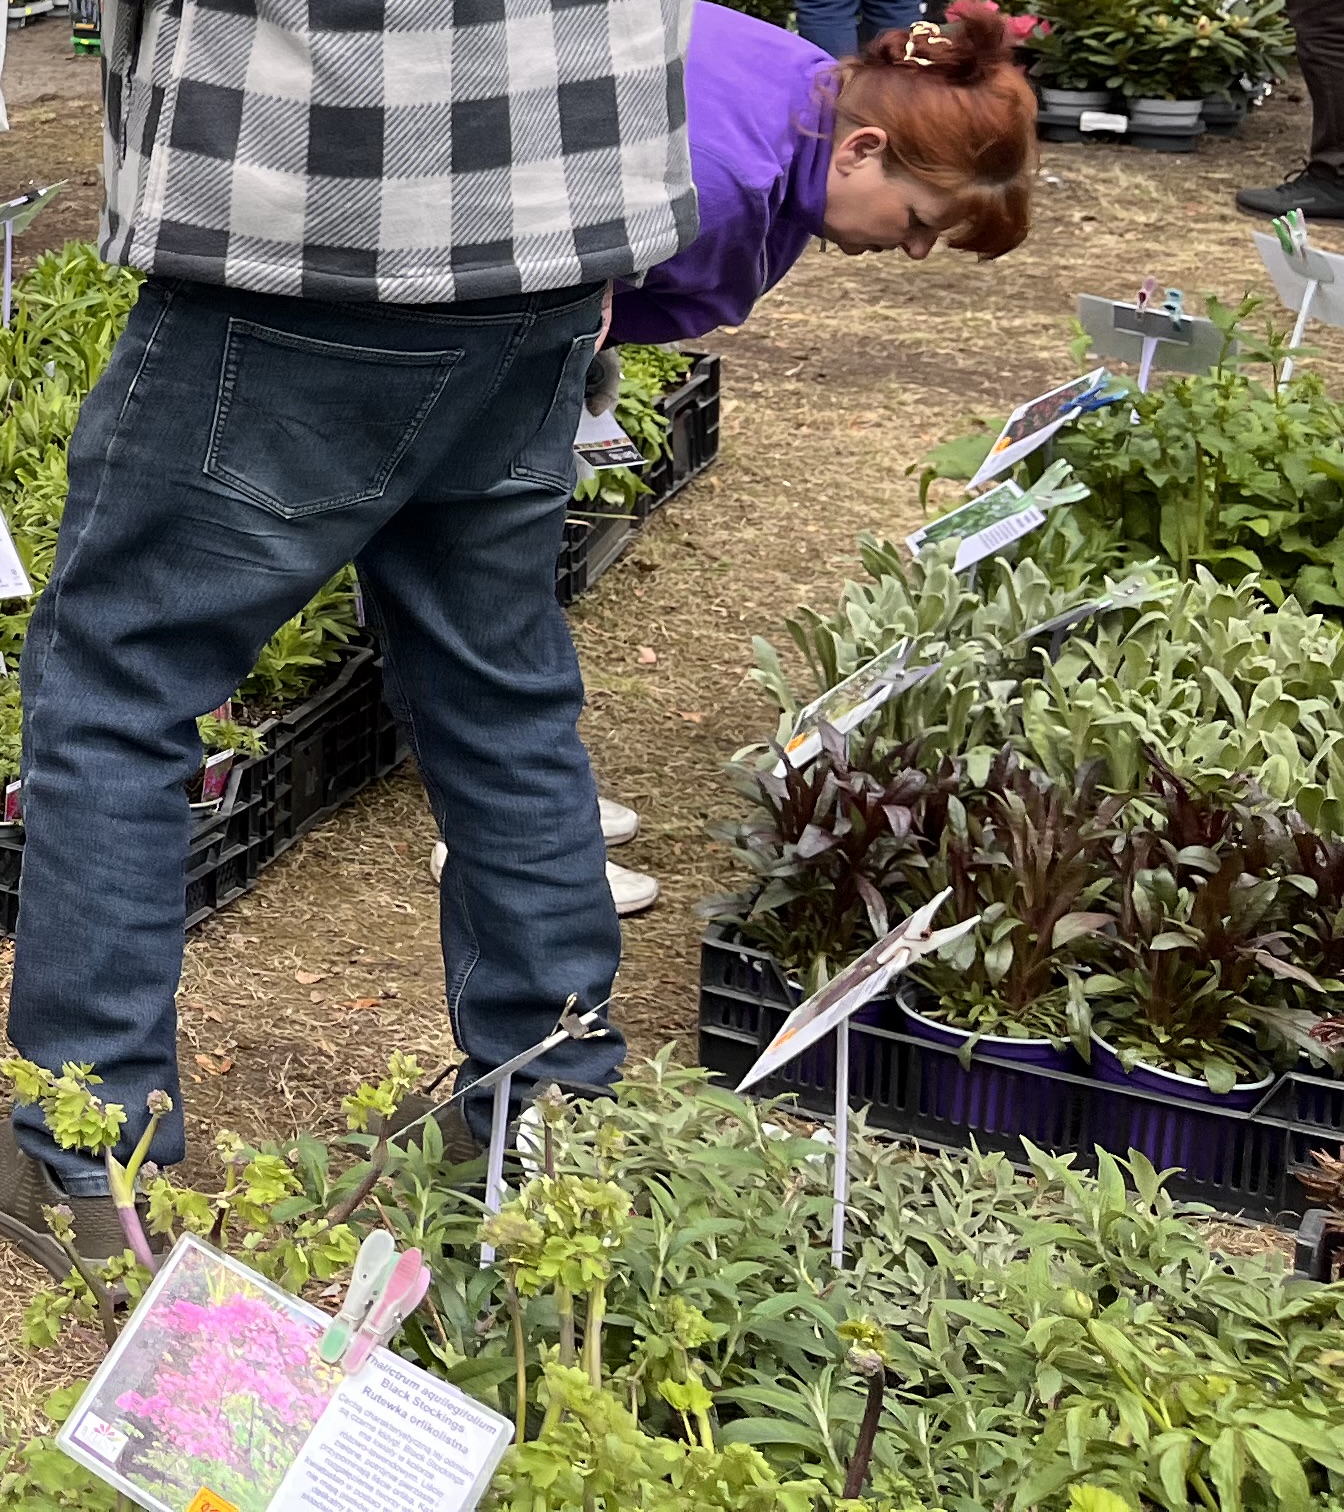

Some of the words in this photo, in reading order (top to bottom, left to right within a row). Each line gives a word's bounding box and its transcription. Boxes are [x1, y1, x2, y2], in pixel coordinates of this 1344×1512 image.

[361, 1385, 410, 1419] Rutewka
[407, 1412, 471, 1455] orlikolistna
[379, 1377, 412, 1402] Black
[410, 1395, 467, 1434] Stockings
